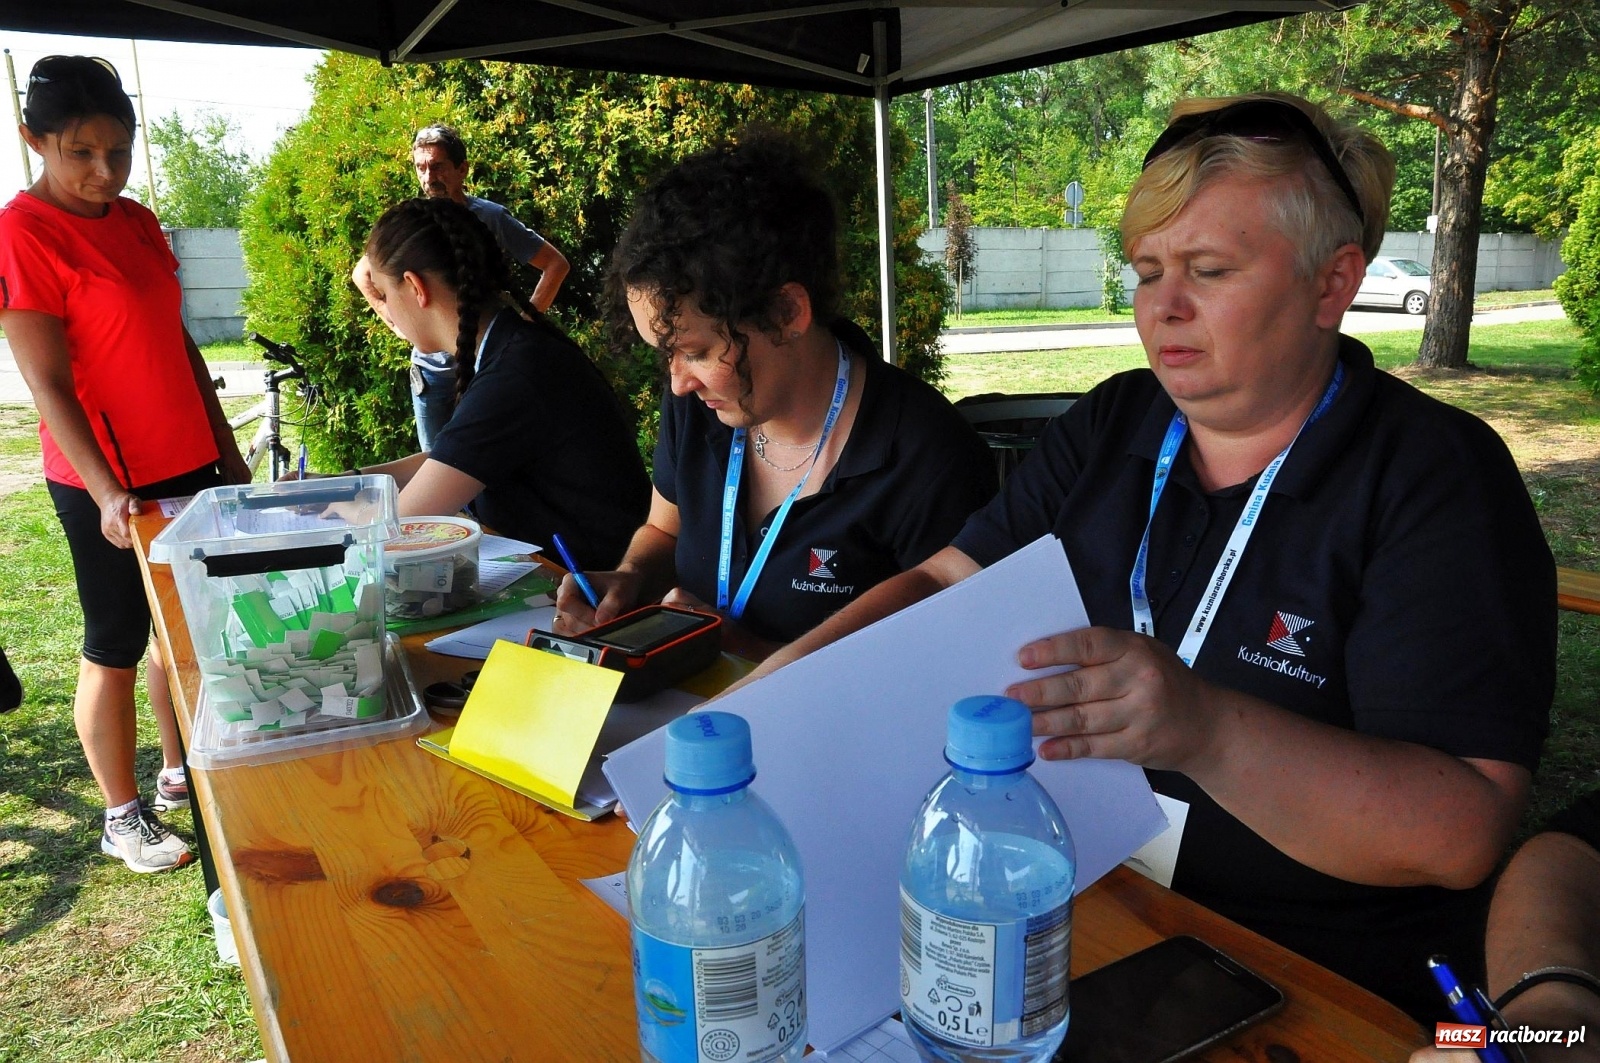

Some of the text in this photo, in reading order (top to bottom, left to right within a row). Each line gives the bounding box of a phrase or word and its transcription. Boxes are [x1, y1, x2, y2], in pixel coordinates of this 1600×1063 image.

[1242, 459, 1281, 527] Gmina Kuźnia
[1194, 549, 1237, 634] www.kuzniaraciborska.pl
[1237, 645, 1326, 689] KuźniaKultury
[778, 1017, 795, 1043] 0,5
[938, 1010, 960, 1031] 0,5
[964, 1018, 974, 1035] L
